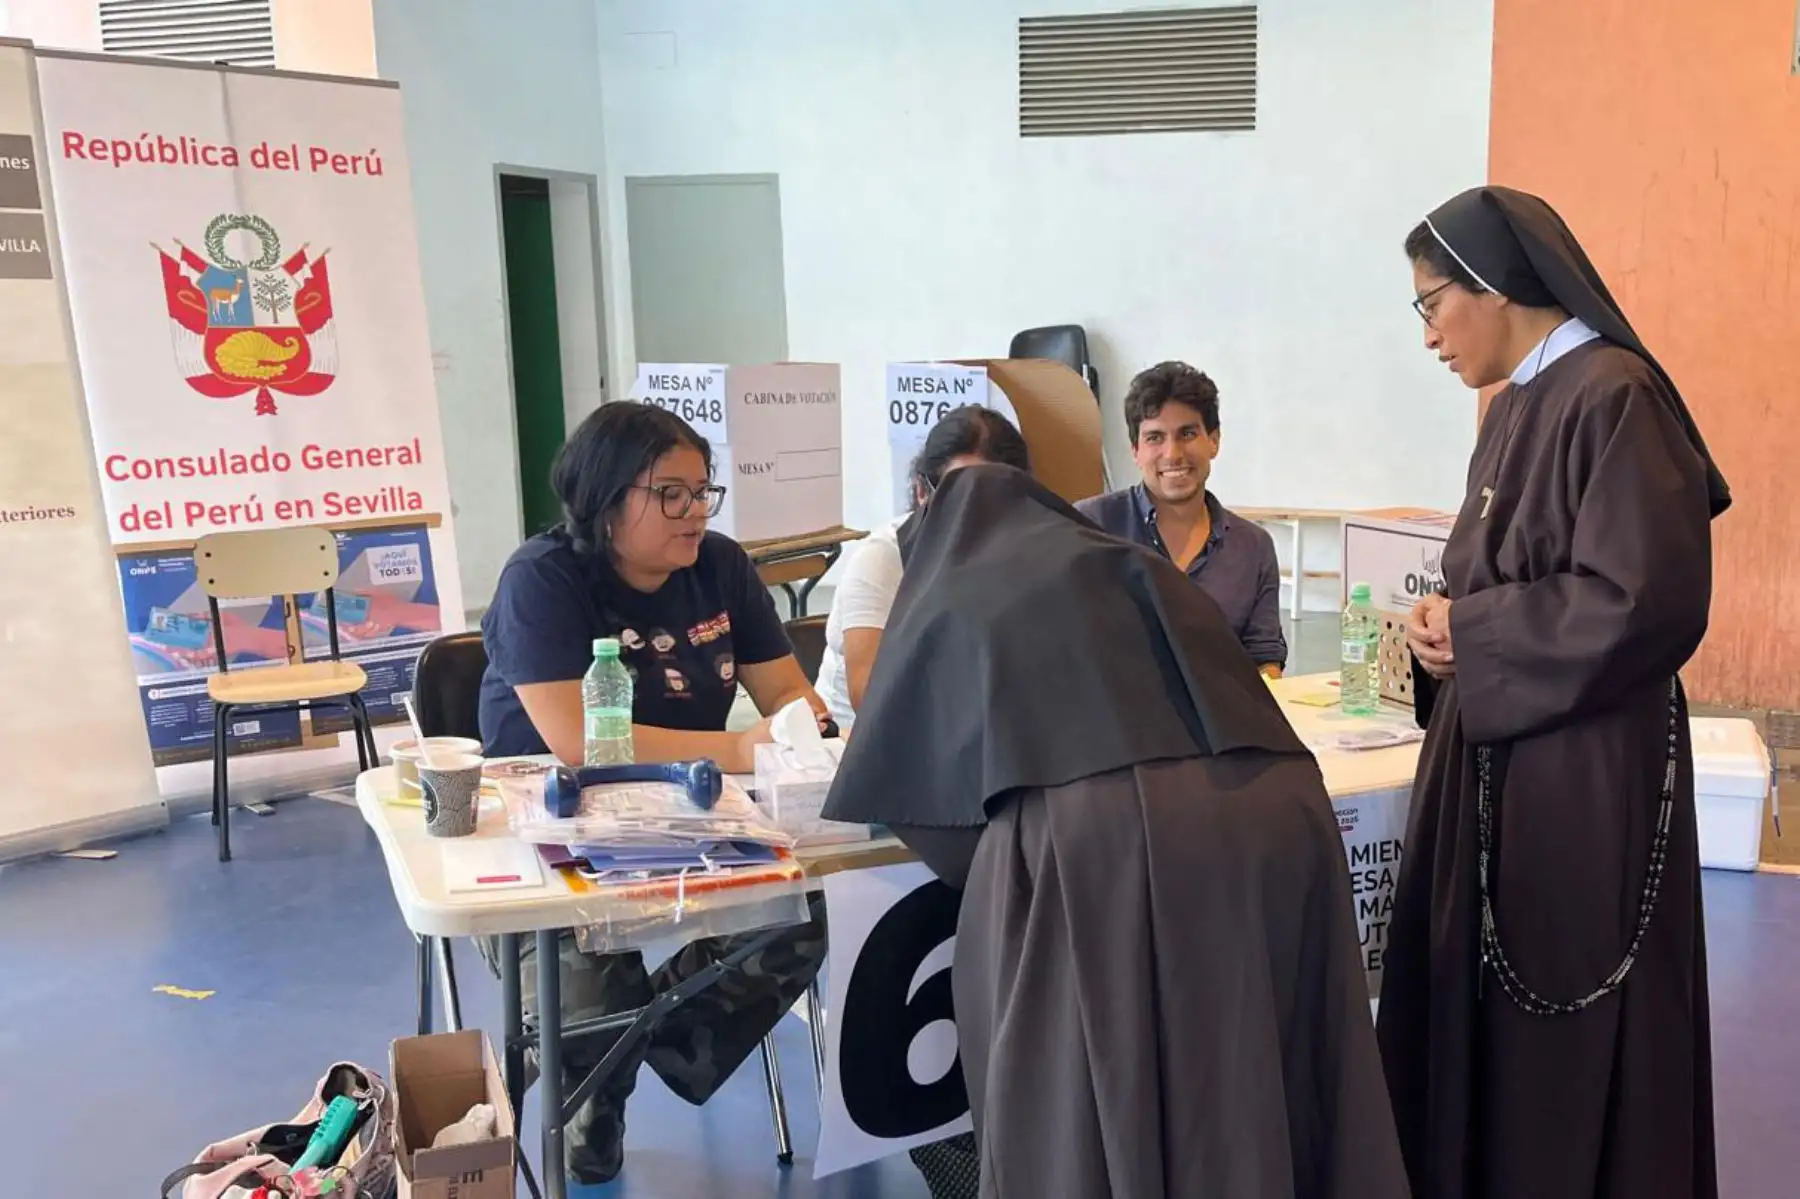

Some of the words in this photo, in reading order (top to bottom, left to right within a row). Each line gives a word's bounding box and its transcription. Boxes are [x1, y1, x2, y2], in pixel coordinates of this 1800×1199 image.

[62, 131, 239, 167] República
[250, 142, 299, 171] del
[310, 146, 383, 176] Perú
[649, 374, 691, 391] MESA
[897, 377, 949, 393] MESA
[744, 392, 784, 405] CABINA
[105, 446, 291, 481] Consulado
[301, 438, 421, 470] General
[738, 462, 764, 475] MESA
[0, 505, 76, 523] teriores
[119, 502, 172, 533] del
[185, 494, 263, 527] Perú
[275, 497, 313, 519] en
[323, 486, 422, 516] Sevilla
[839, 878, 970, 1138] 6
